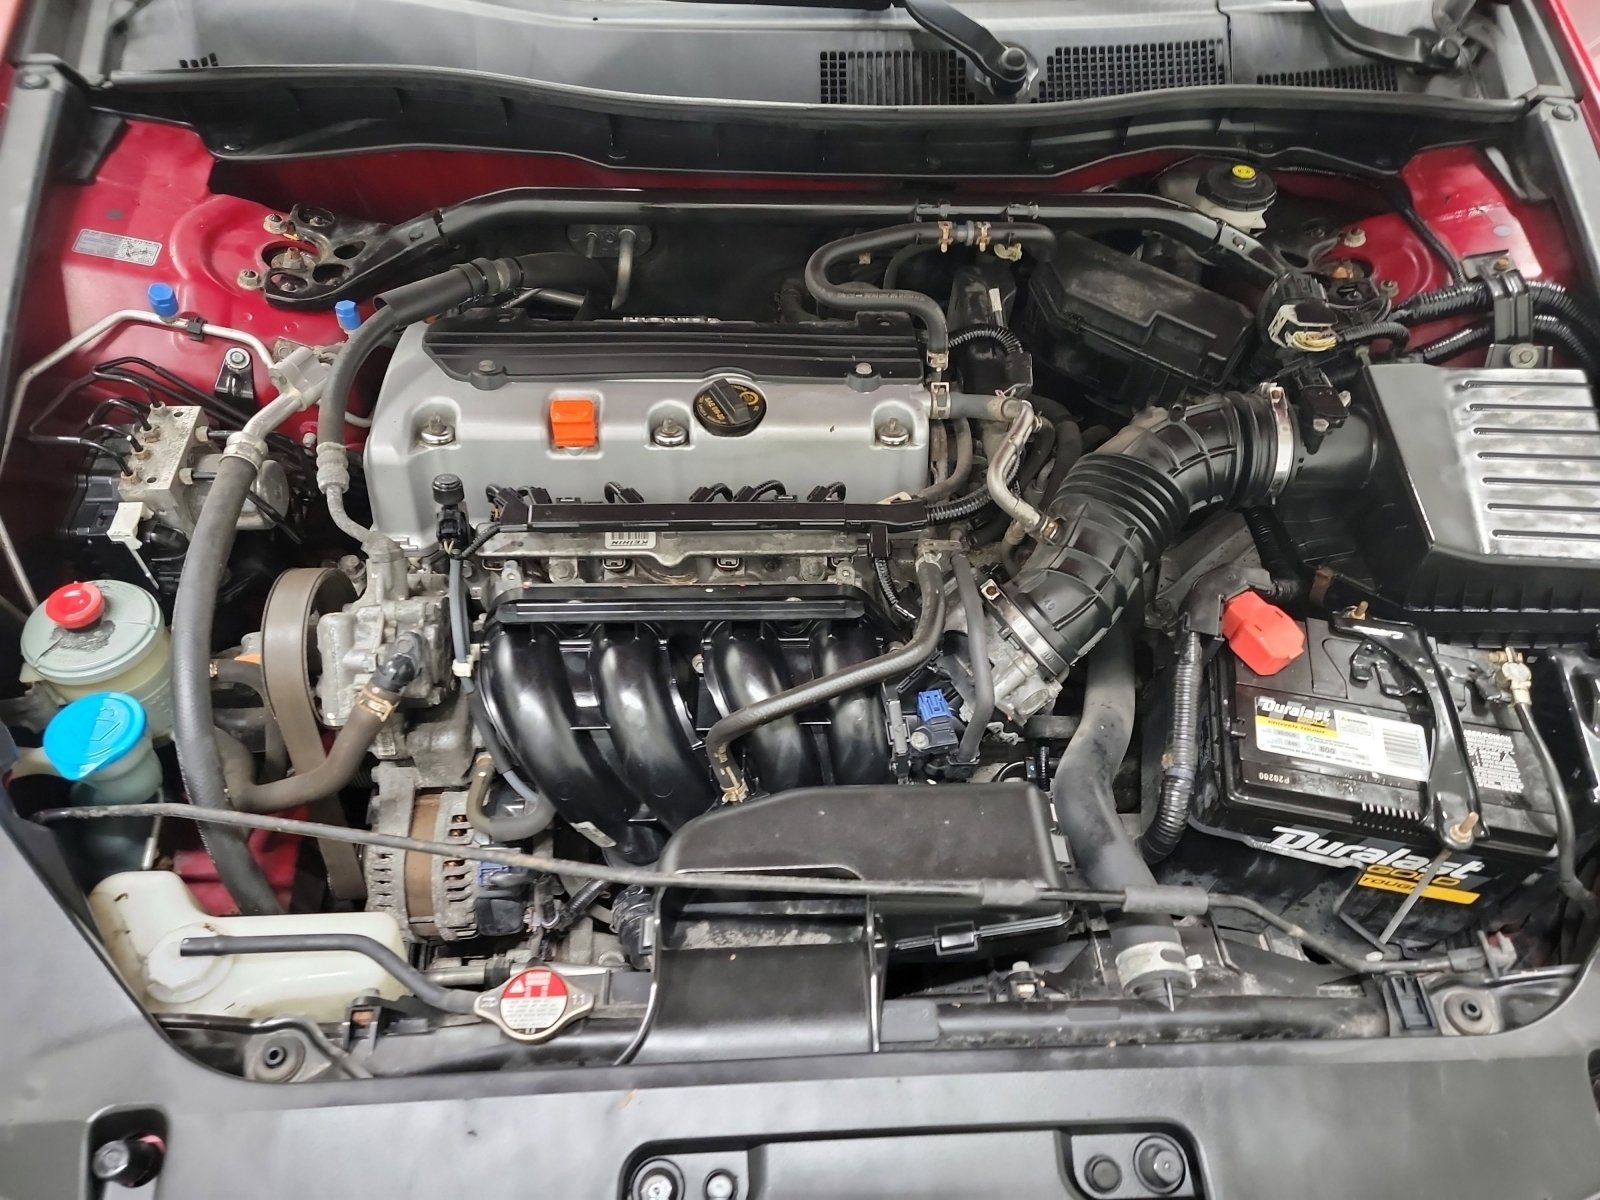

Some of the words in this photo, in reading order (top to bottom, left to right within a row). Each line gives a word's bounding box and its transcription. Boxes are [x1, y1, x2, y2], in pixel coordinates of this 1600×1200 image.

[1259, 698, 1331, 721] Duralast
[1259, 772, 1290, 785] P20200
[1272, 826, 1484, 879] Duralast
